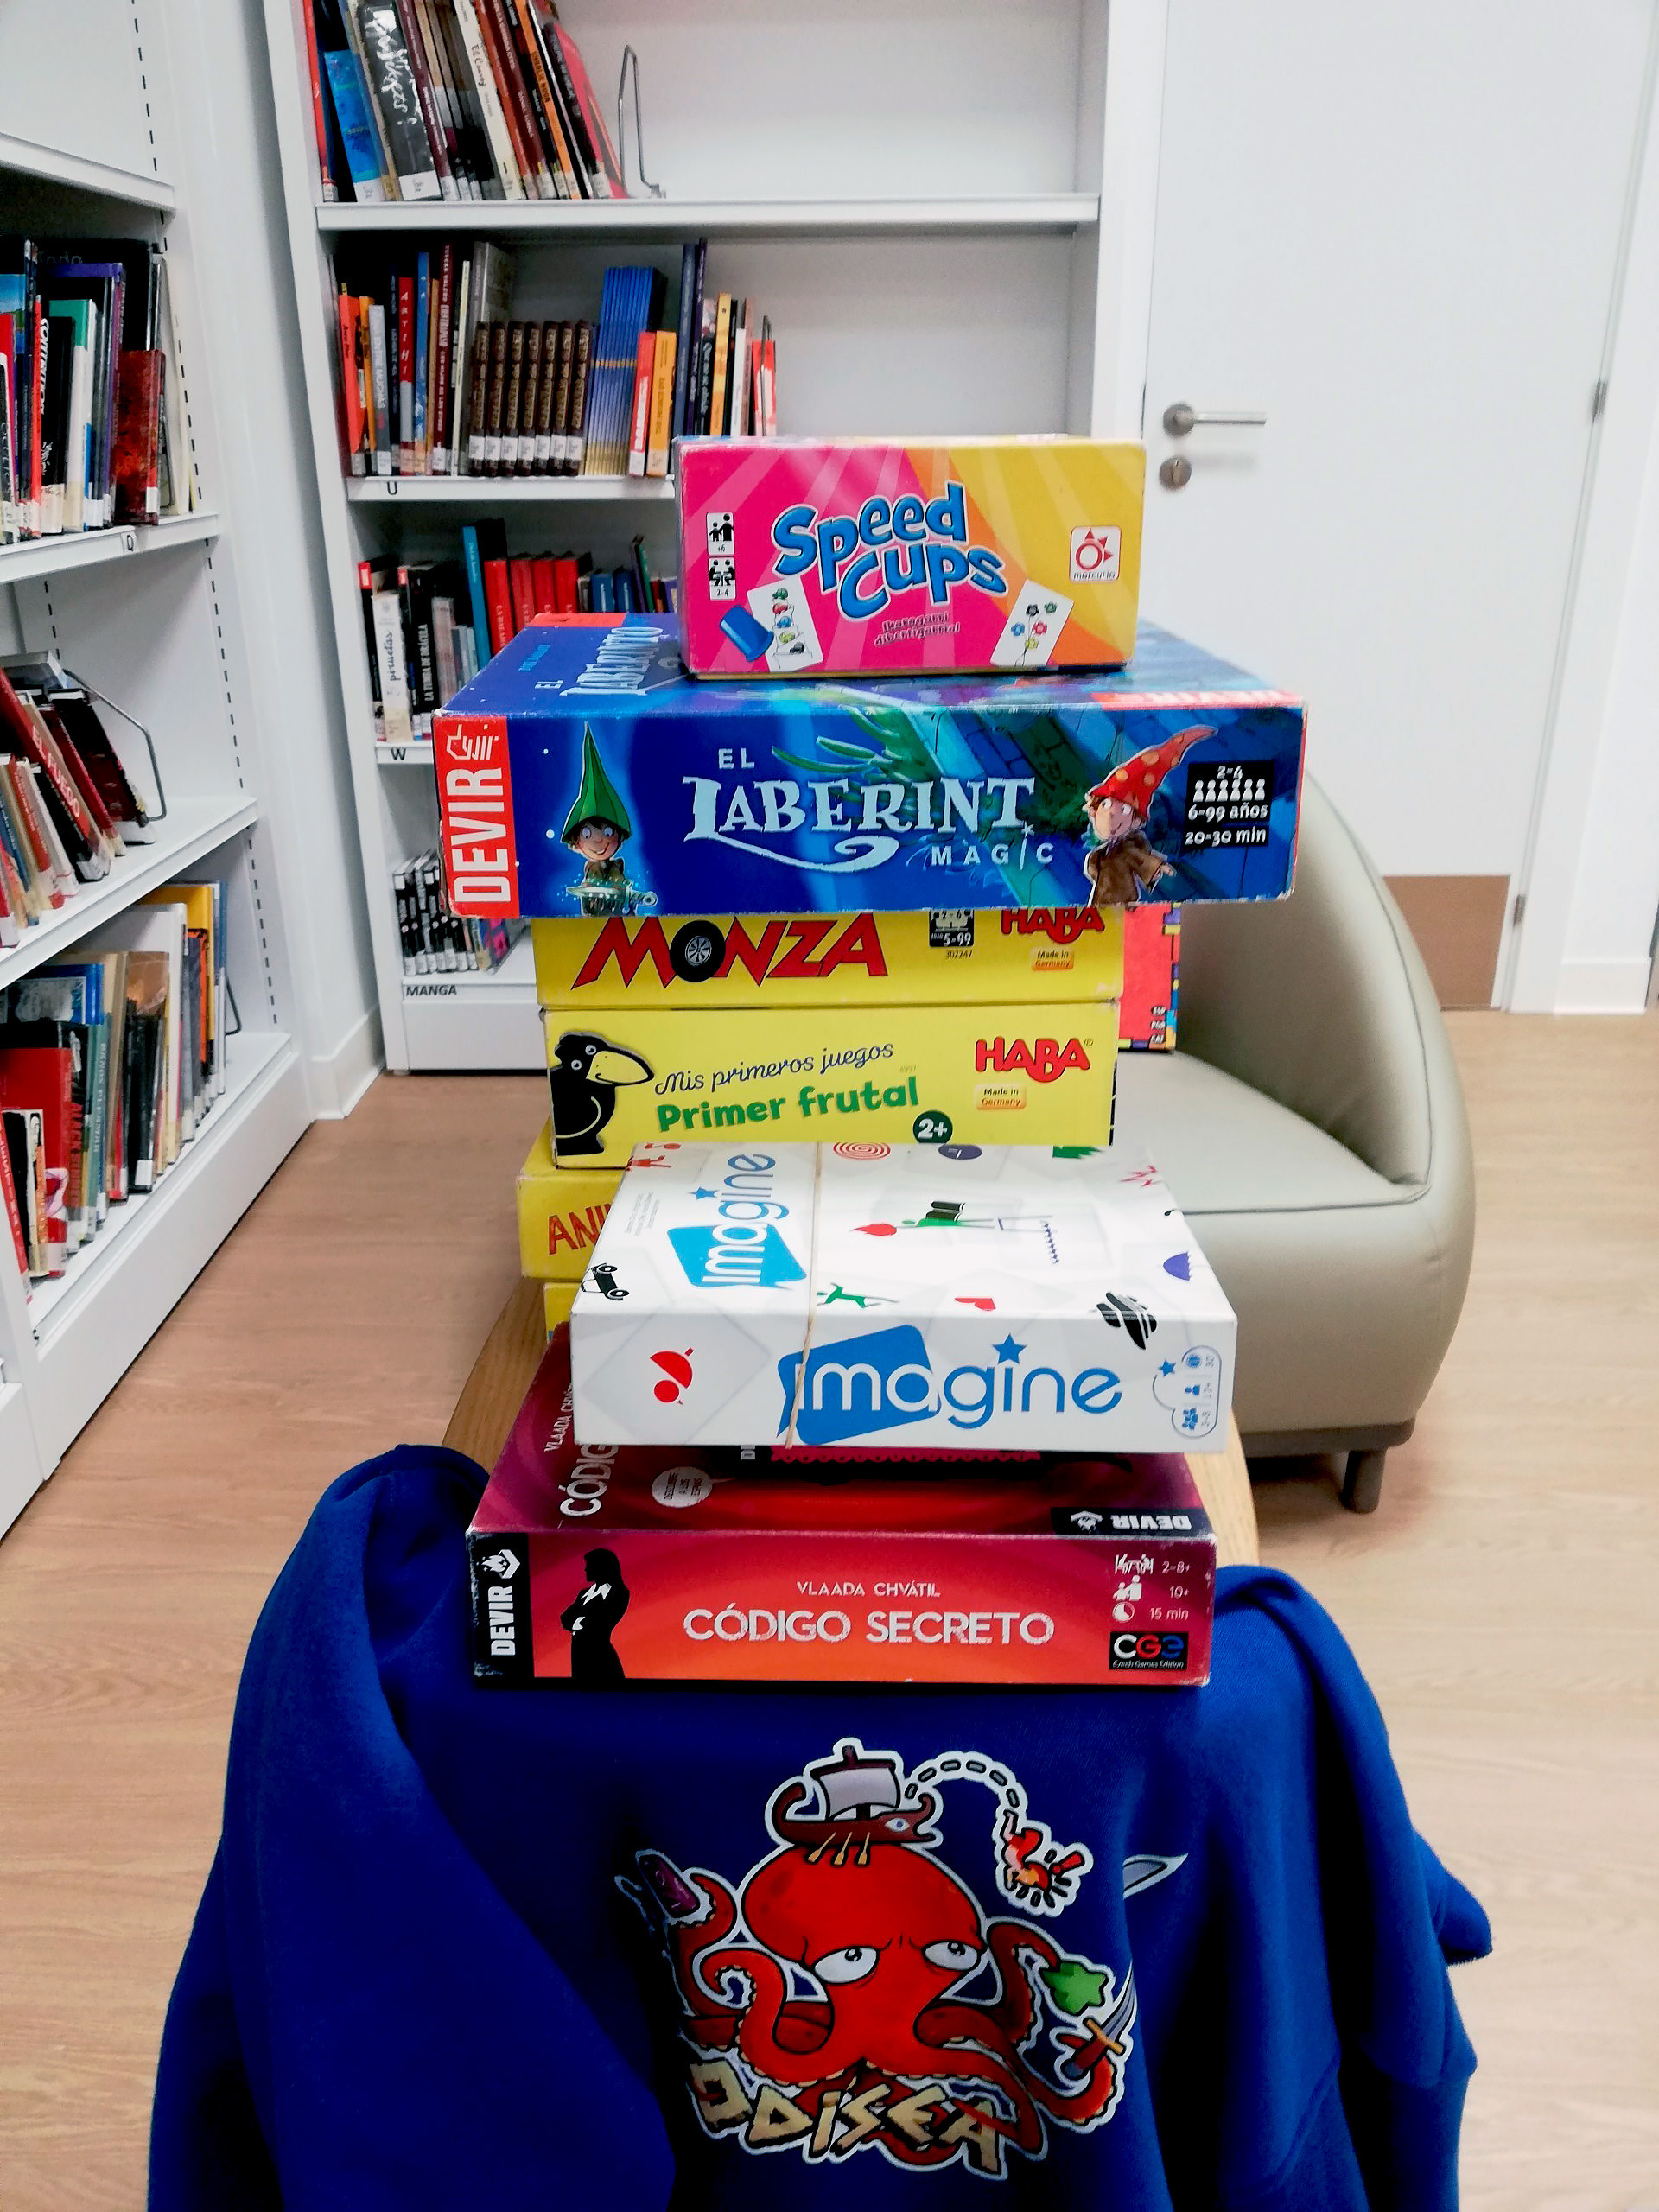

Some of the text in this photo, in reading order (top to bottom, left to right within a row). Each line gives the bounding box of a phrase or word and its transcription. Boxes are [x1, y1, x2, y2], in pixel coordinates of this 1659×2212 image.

[386, 480, 398, 496] U
[771, 480, 969, 594] Speed
[837, 542, 1008, 622] Cups
[391, 747, 406, 760] W
[718, 747, 755, 769] EL
[1217, 765, 1244, 780] 2-4
[1187, 804, 1268, 821] 6-99 años
[446, 767, 512, 903] DEVIR
[682, 776, 1036, 873] LABERINT
[1185, 826, 1267, 848] 20-30 min
[1001, 907, 1106, 944] HABA
[571, 912, 888, 990] MONZA
[1035, 959, 1071, 969] Germany
[406, 984, 458, 997] MANGA
[655, 1043, 894, 1095] Mis primeros juegos
[975, 1036, 1091, 1083] HABA
[981, 1097, 1021, 1108] Germany
[983, 1087, 1019, 1097] Made in
[657, 1075, 919, 1133] Primer frutal
[918, 1117, 949, 1140] 2+
[548, 1202, 612, 1255] ANI
[687, 1154, 790, 1285] imagine
[558, 1444, 620, 1516] CÓDIG
[1110, 1515, 1192, 1530] DEVIR
[1161, 1560, 1192, 1574] 2-8+
[797, 1580, 941, 1598] VLAADA CHVÁTIL
[1169, 1586, 1190, 1599] 10+
[488, 1586, 516, 1656] DEVIR
[683, 1603, 1054, 1646] CÓDIGO SECRETO
[1149, 1608, 1189, 1621] 15 min
